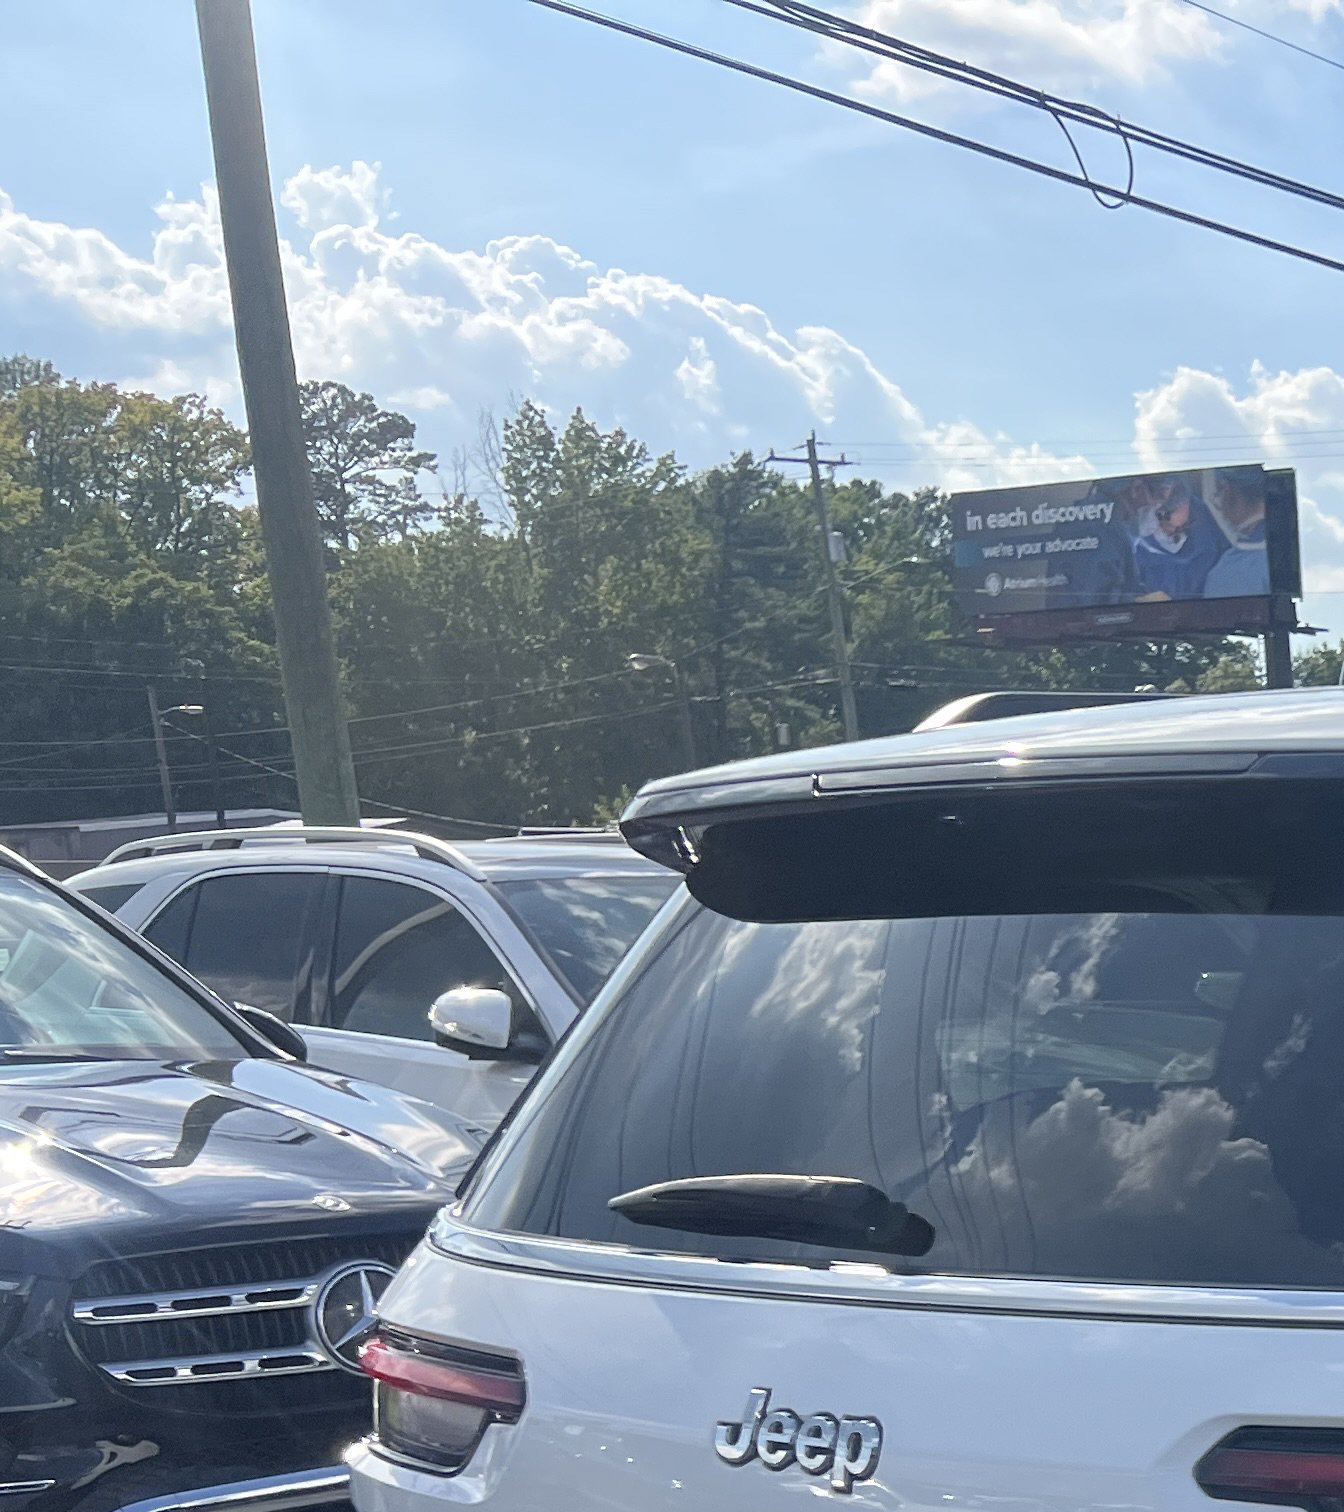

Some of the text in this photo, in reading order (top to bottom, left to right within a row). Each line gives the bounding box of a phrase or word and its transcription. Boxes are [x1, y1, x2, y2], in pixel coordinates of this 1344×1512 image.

[966, 502, 1114, 531] in each discovery
[1016, 542, 1042, 559] your
[1045, 536, 1099, 553] advocate
[714, 1387, 883, 1494] Jeep
